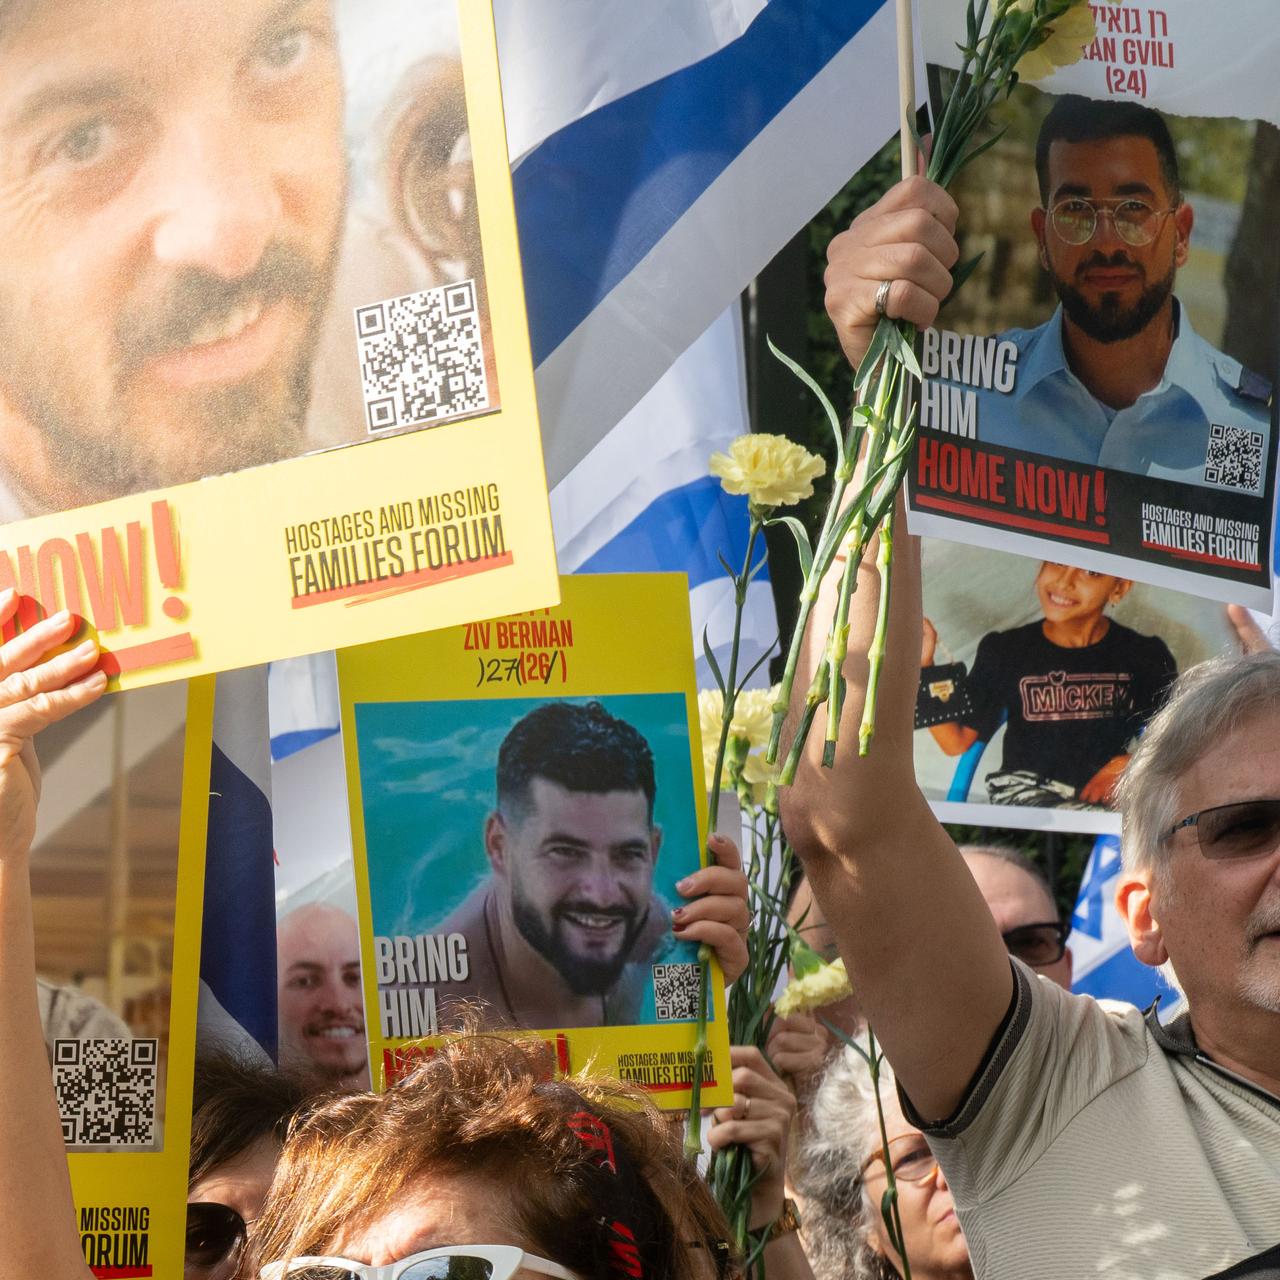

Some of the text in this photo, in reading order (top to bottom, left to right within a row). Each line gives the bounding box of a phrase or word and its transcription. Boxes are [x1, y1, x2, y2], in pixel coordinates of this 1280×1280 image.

[1148, 9, 1168, 38] רן
[1122, 38, 1174, 68] GVILI
[1105, 65, 1147, 99] (24)
[921, 326, 1018, 394] BRING
[919, 377, 978, 440] HIM
[916, 436, 1109, 527] HOME NOW!
[284, 482, 501, 555] HOSTAGES AND MISSING
[1141, 502, 1260, 542] HOSTAGES AND MISSING
[289, 513, 508, 599] FAMILIES FORUM
[1141, 519, 1259, 566] FAMILIES FORUM
[462, 619, 574, 651] ZIV BERMAN
[373, 932, 469, 985] BRING
[377, 988, 440, 1039] HIM
[617, 1052, 659, 1068] HOSTAGES
[659, 1051, 676, 1066] AND
[79, 1206, 151, 1232] MISSING
[79, 1233, 149, 1270] ORUM
